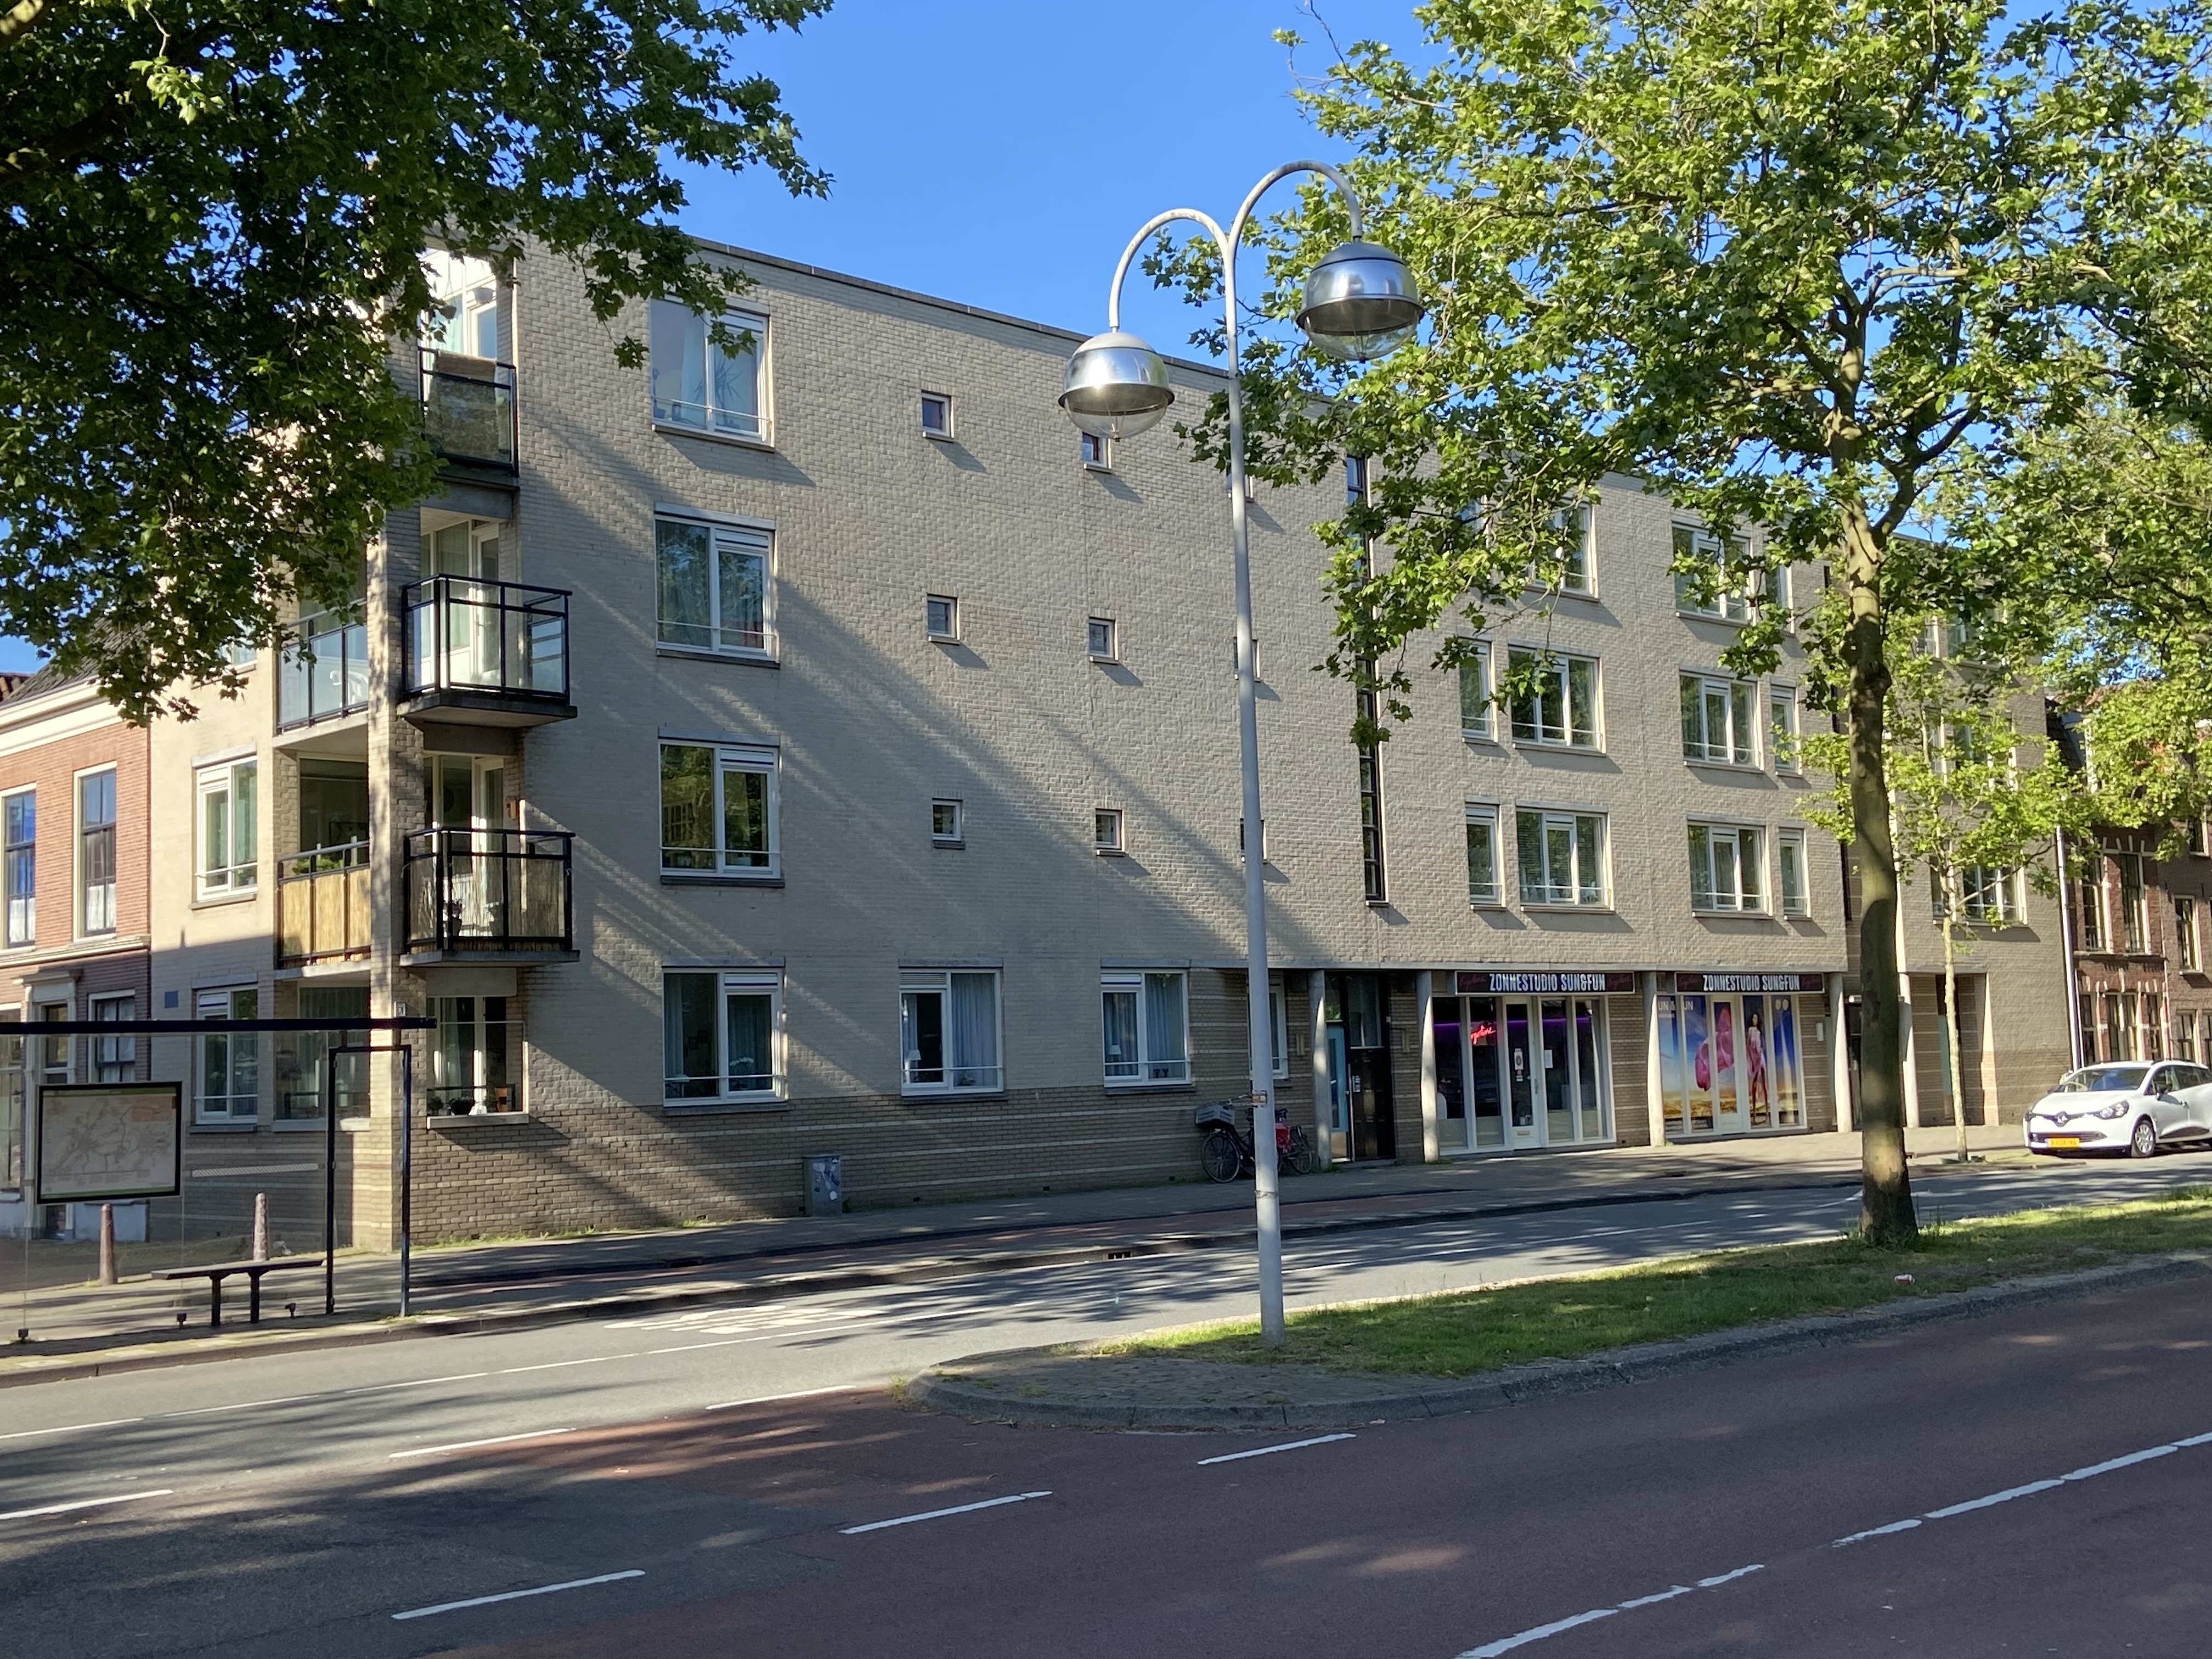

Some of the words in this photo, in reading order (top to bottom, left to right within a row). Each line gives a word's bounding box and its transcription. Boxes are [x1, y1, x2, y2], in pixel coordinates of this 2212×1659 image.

[1489, 973, 1558, 991] ZONNESTUDIO
[1561, 973, 1605, 991] SUN&FUN
[1703, 974, 1759, 991] ZONNESTUDIO
[1763, 975, 1800, 991] SUN&FUN
